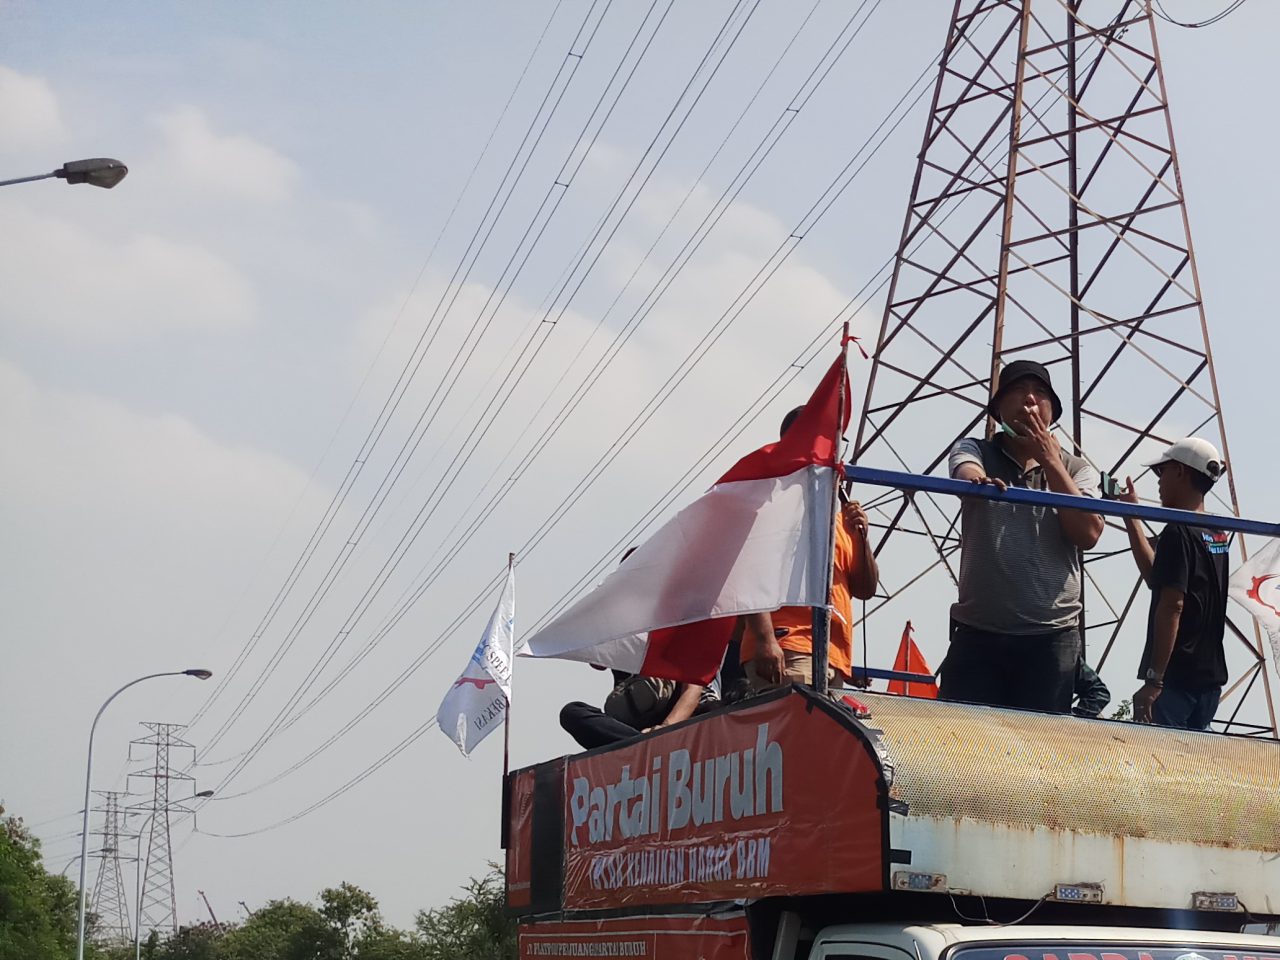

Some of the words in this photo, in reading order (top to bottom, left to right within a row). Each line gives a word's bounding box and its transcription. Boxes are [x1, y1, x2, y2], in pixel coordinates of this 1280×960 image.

[570, 755, 662, 845] Partai
[668, 723, 784, 829] Buruh
[736, 837, 771, 880] BBM
